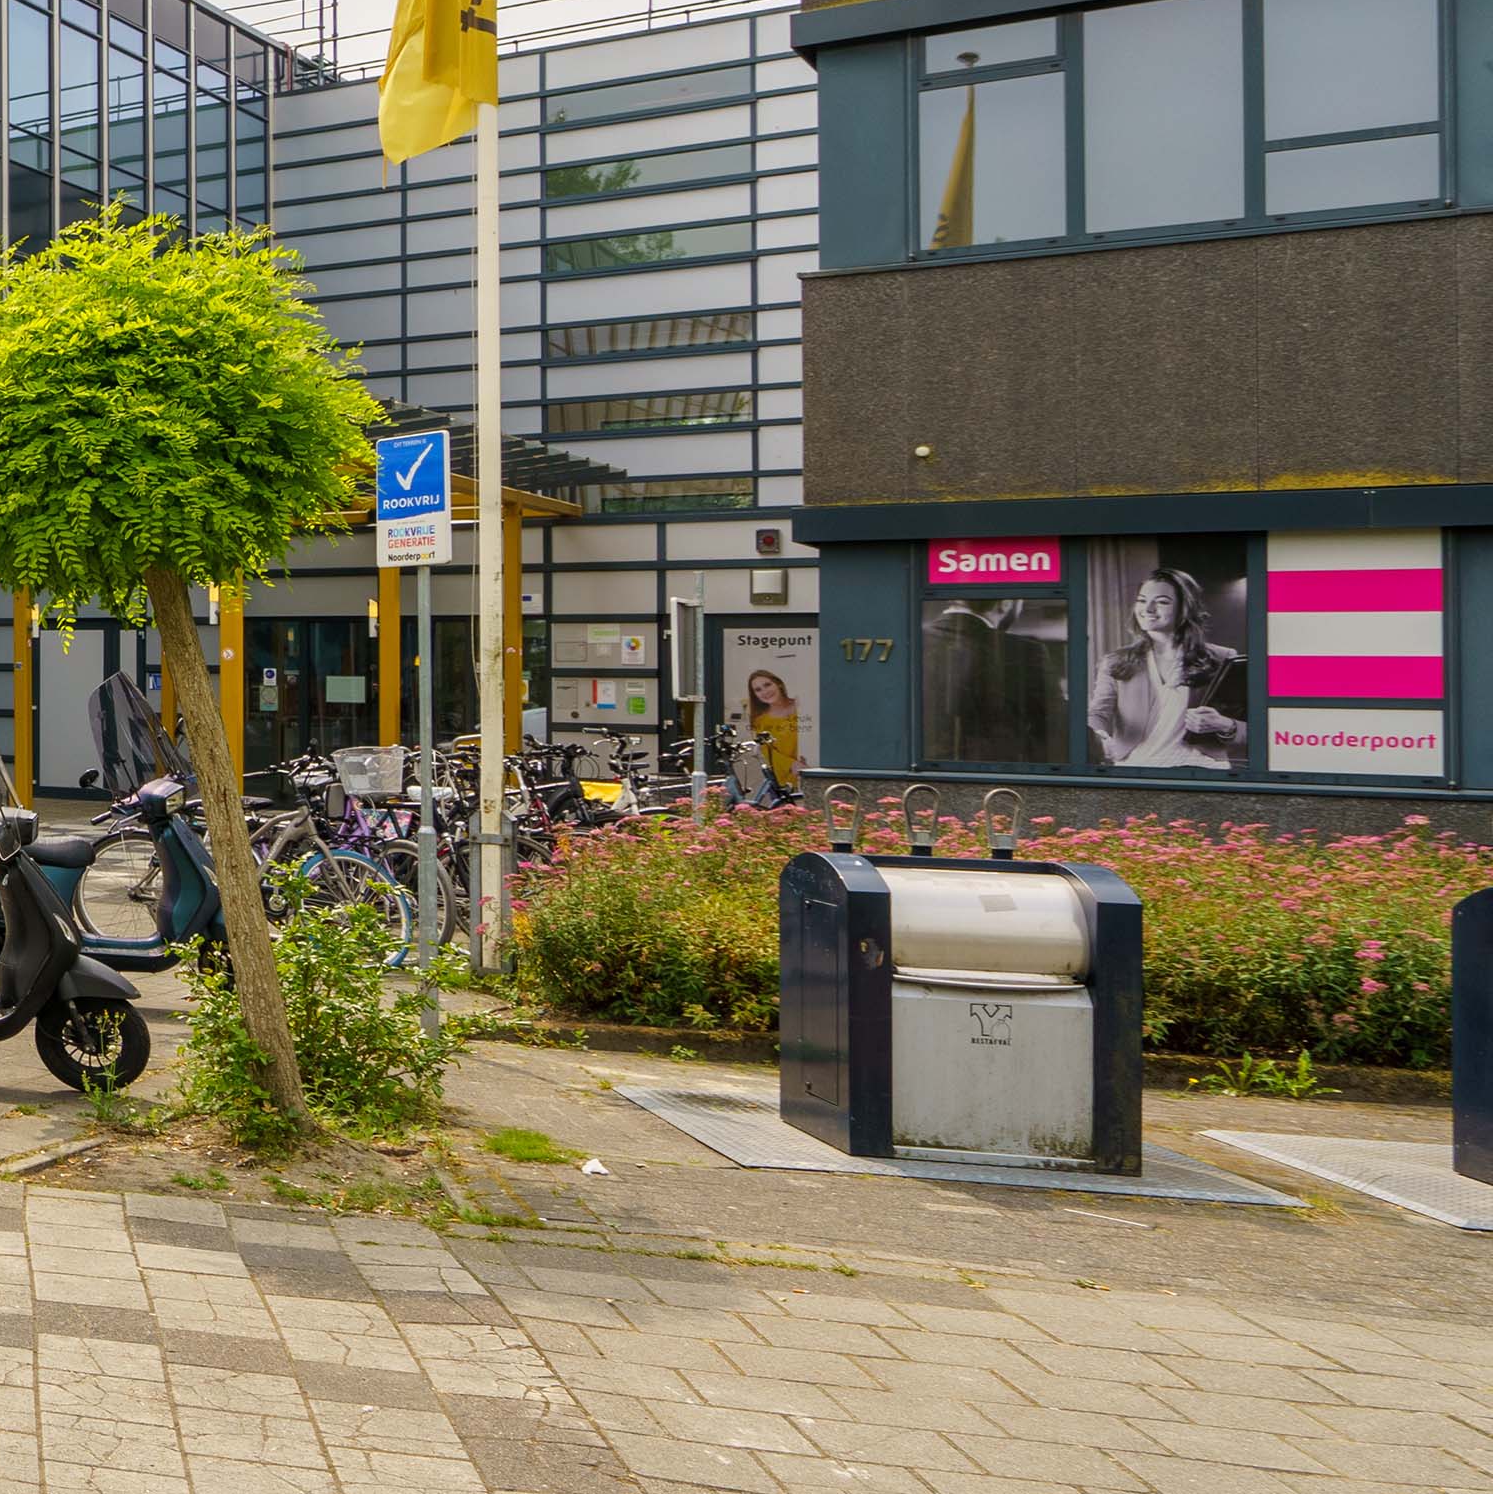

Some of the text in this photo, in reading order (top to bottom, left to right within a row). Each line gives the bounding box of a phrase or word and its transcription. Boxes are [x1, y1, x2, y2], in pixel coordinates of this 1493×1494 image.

[383, 494, 440, 510] ROOKVRIJ
[388, 525, 435, 538] ROOKVRIJE
[388, 536, 435, 549] GENERATIE
[388, 551, 435, 563] Noorderpoort
[938, 548, 1051, 574] Samen
[737, 635, 812, 648] Stagepunt
[839, 638, 895, 662] 177
[1274, 729, 1436, 751] Noorderpoort
